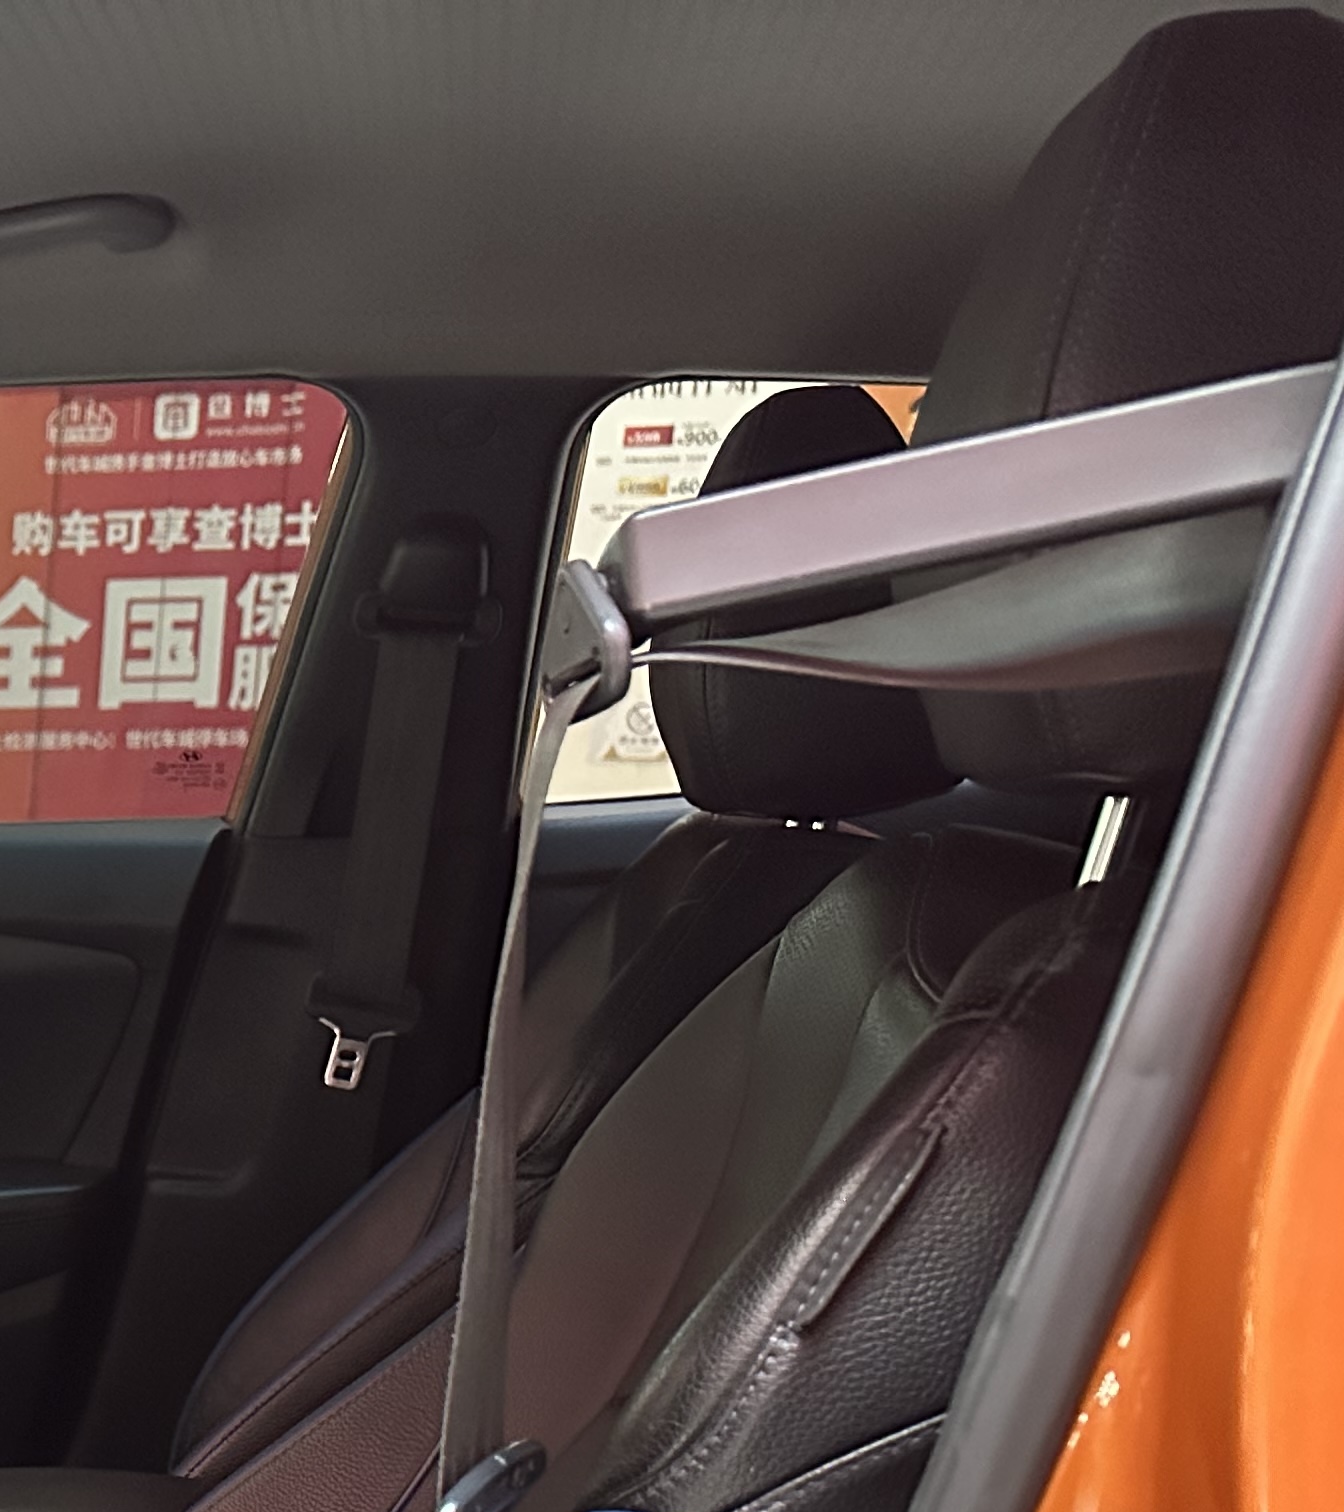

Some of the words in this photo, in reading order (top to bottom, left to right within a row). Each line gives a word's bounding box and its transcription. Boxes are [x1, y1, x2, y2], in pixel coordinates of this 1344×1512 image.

[12, 500, 319, 556] 购车可享查博士
